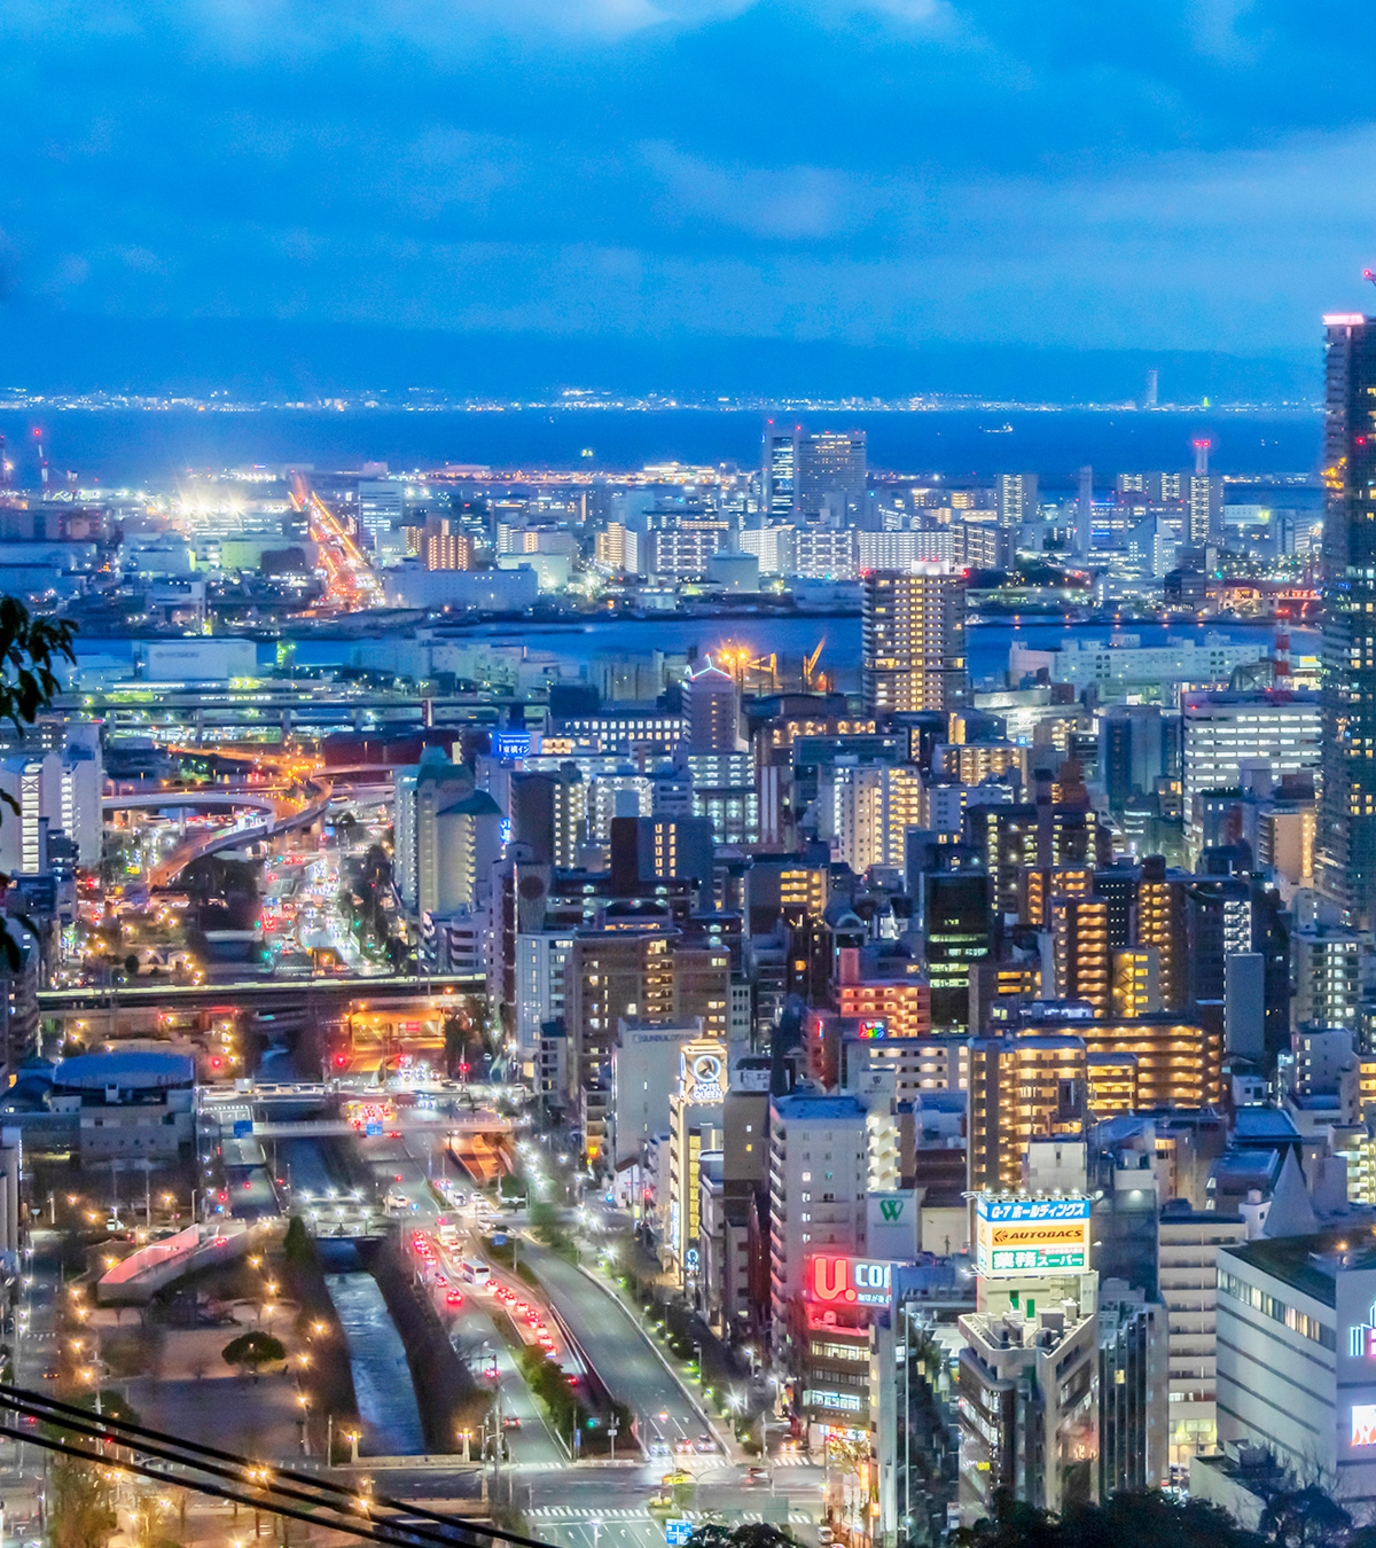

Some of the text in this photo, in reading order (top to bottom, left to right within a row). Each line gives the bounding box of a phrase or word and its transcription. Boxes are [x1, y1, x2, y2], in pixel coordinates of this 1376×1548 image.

[694, 1091, 723, 1099] QUEEN
[991, 1205, 1012, 1218] G-7
[1012, 1203, 1085, 1218] ホールディングス
[1010, 1229, 1083, 1240] AUTOBACS
